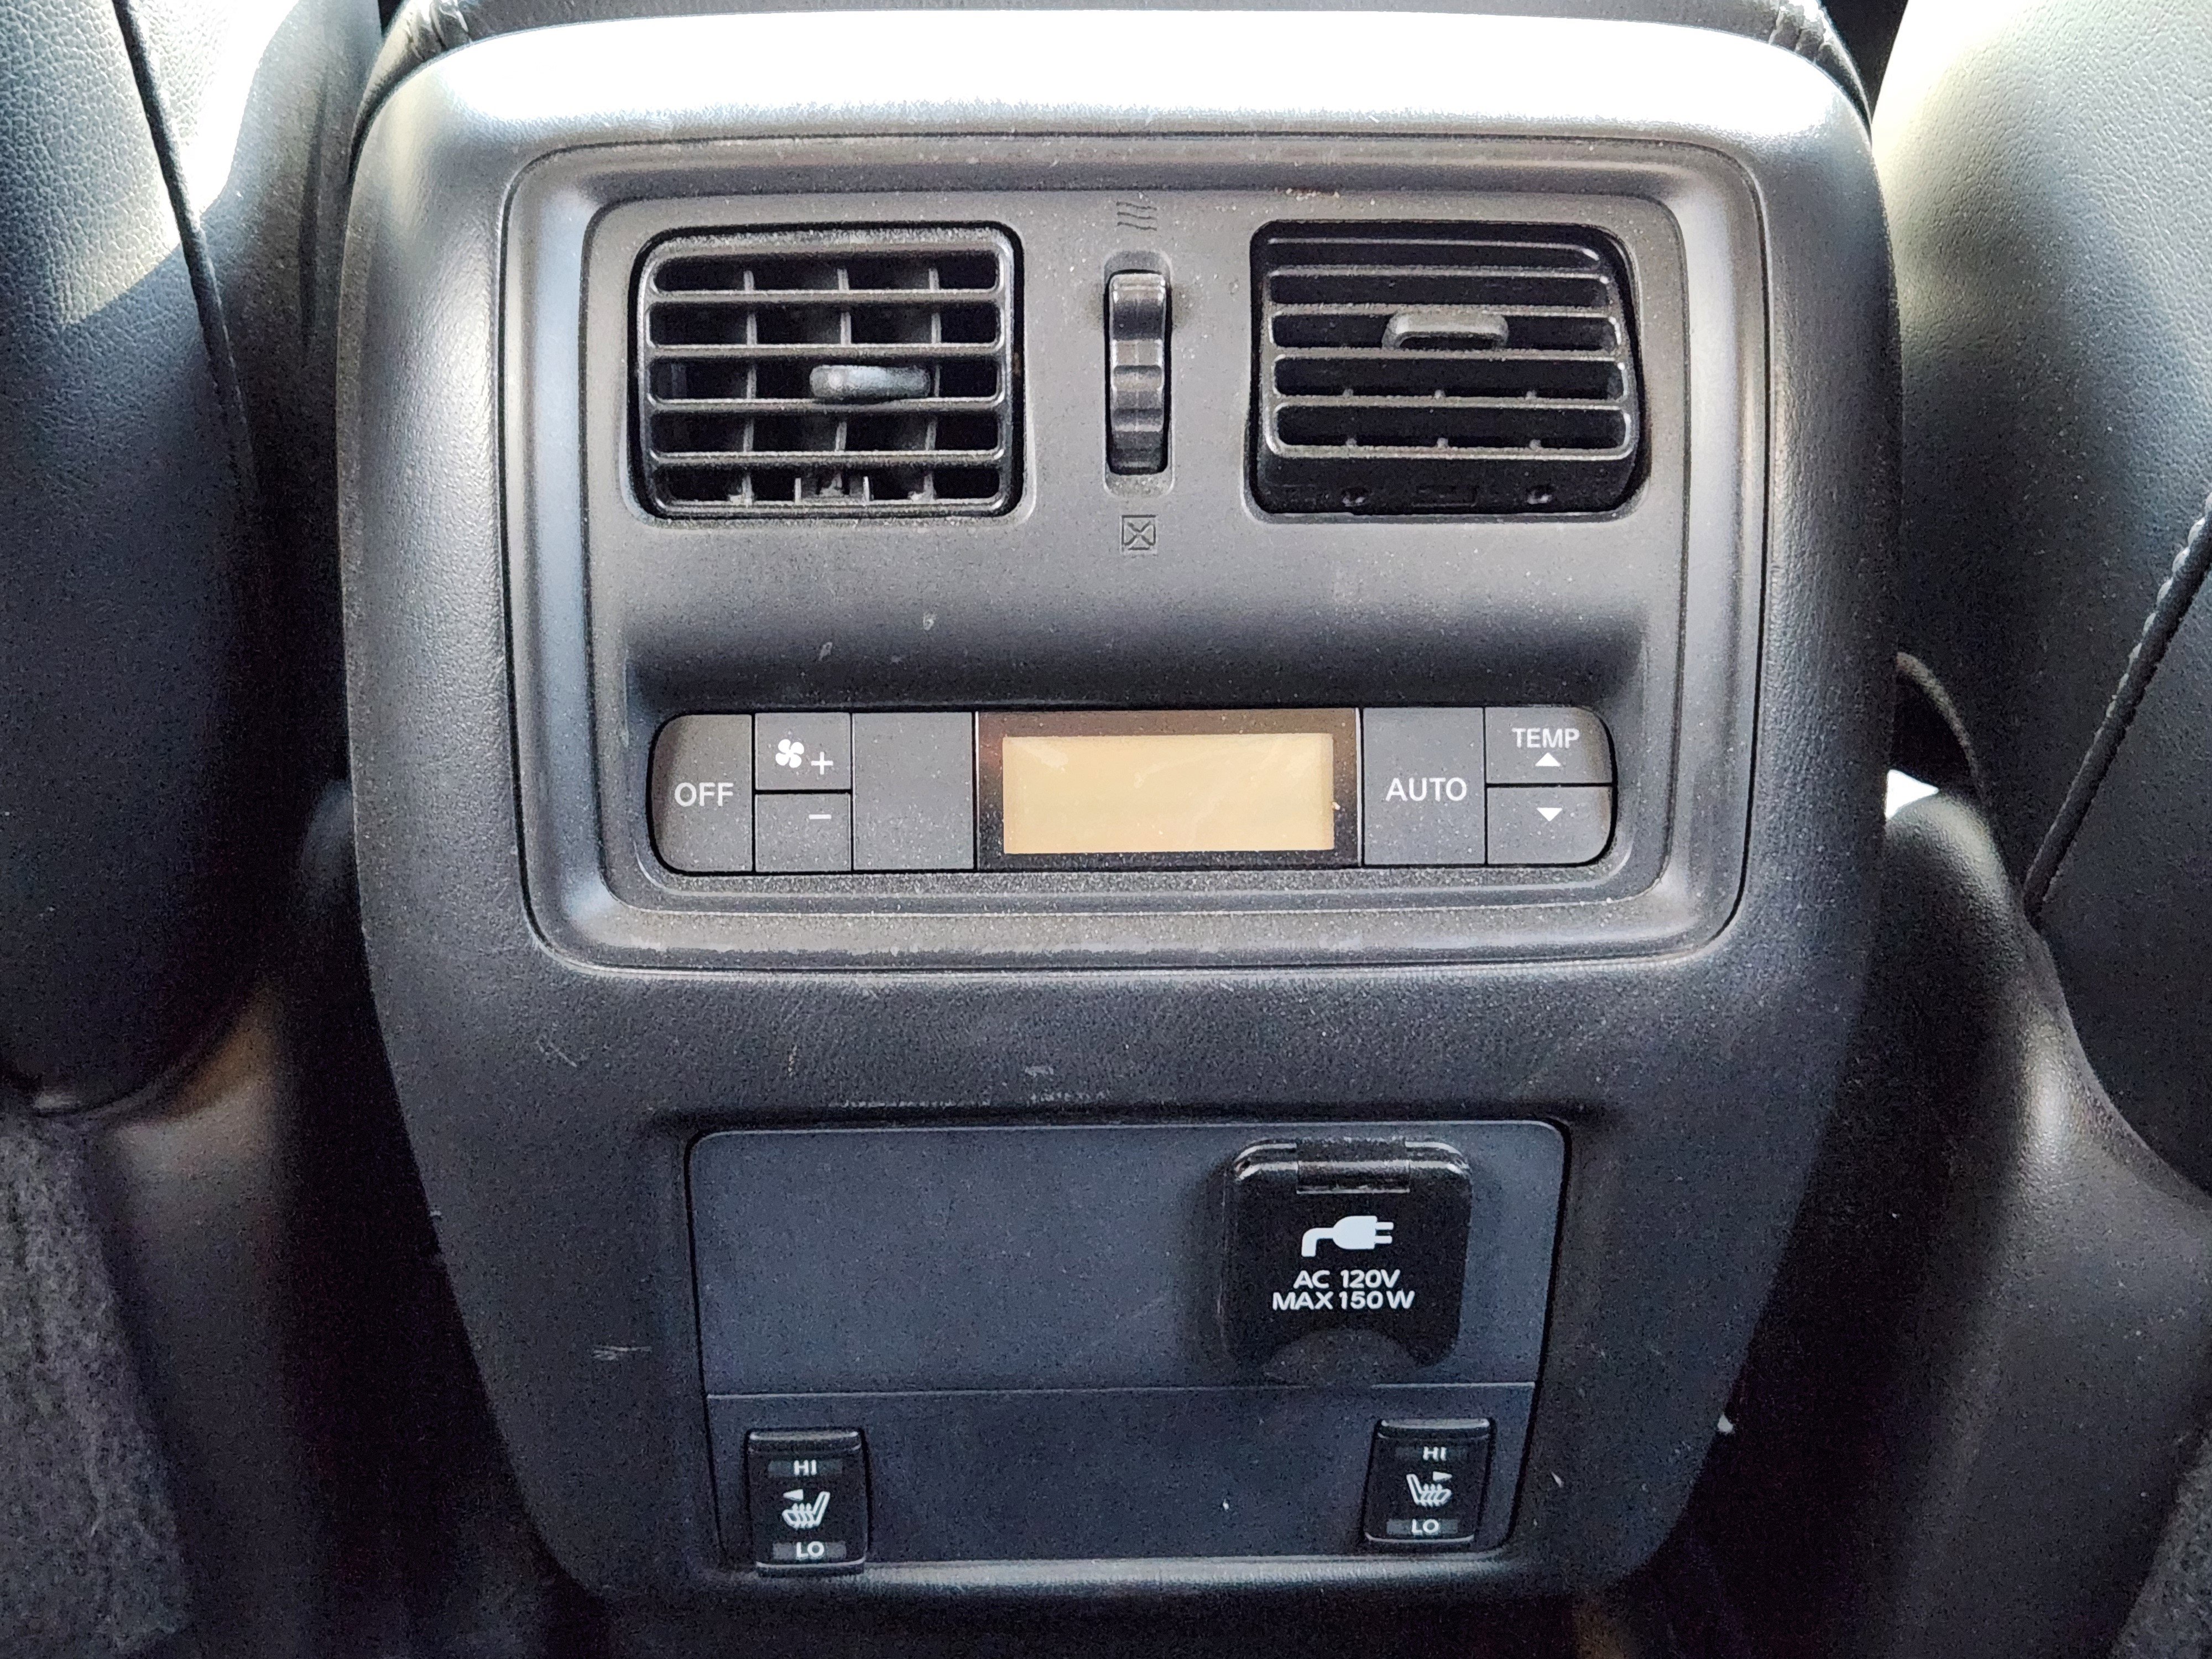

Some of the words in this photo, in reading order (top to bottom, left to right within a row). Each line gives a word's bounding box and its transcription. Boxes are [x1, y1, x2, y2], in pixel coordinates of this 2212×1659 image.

[1512, 727, 1580, 748] TEMP
[674, 782, 734, 807] OFF
[1385, 777, 1468, 802] AUTO
[1293, 1270, 1331, 1289] AC
[1340, 1269, 1400, 1289] 120V
[1272, 1291, 1334, 1311] MAX
[1423, 1446, 1447, 1461] HI
[794, 1459, 817, 1476] HI
[1412, 1519, 1439, 1535] LO
[796, 1541, 825, 1559] LO
